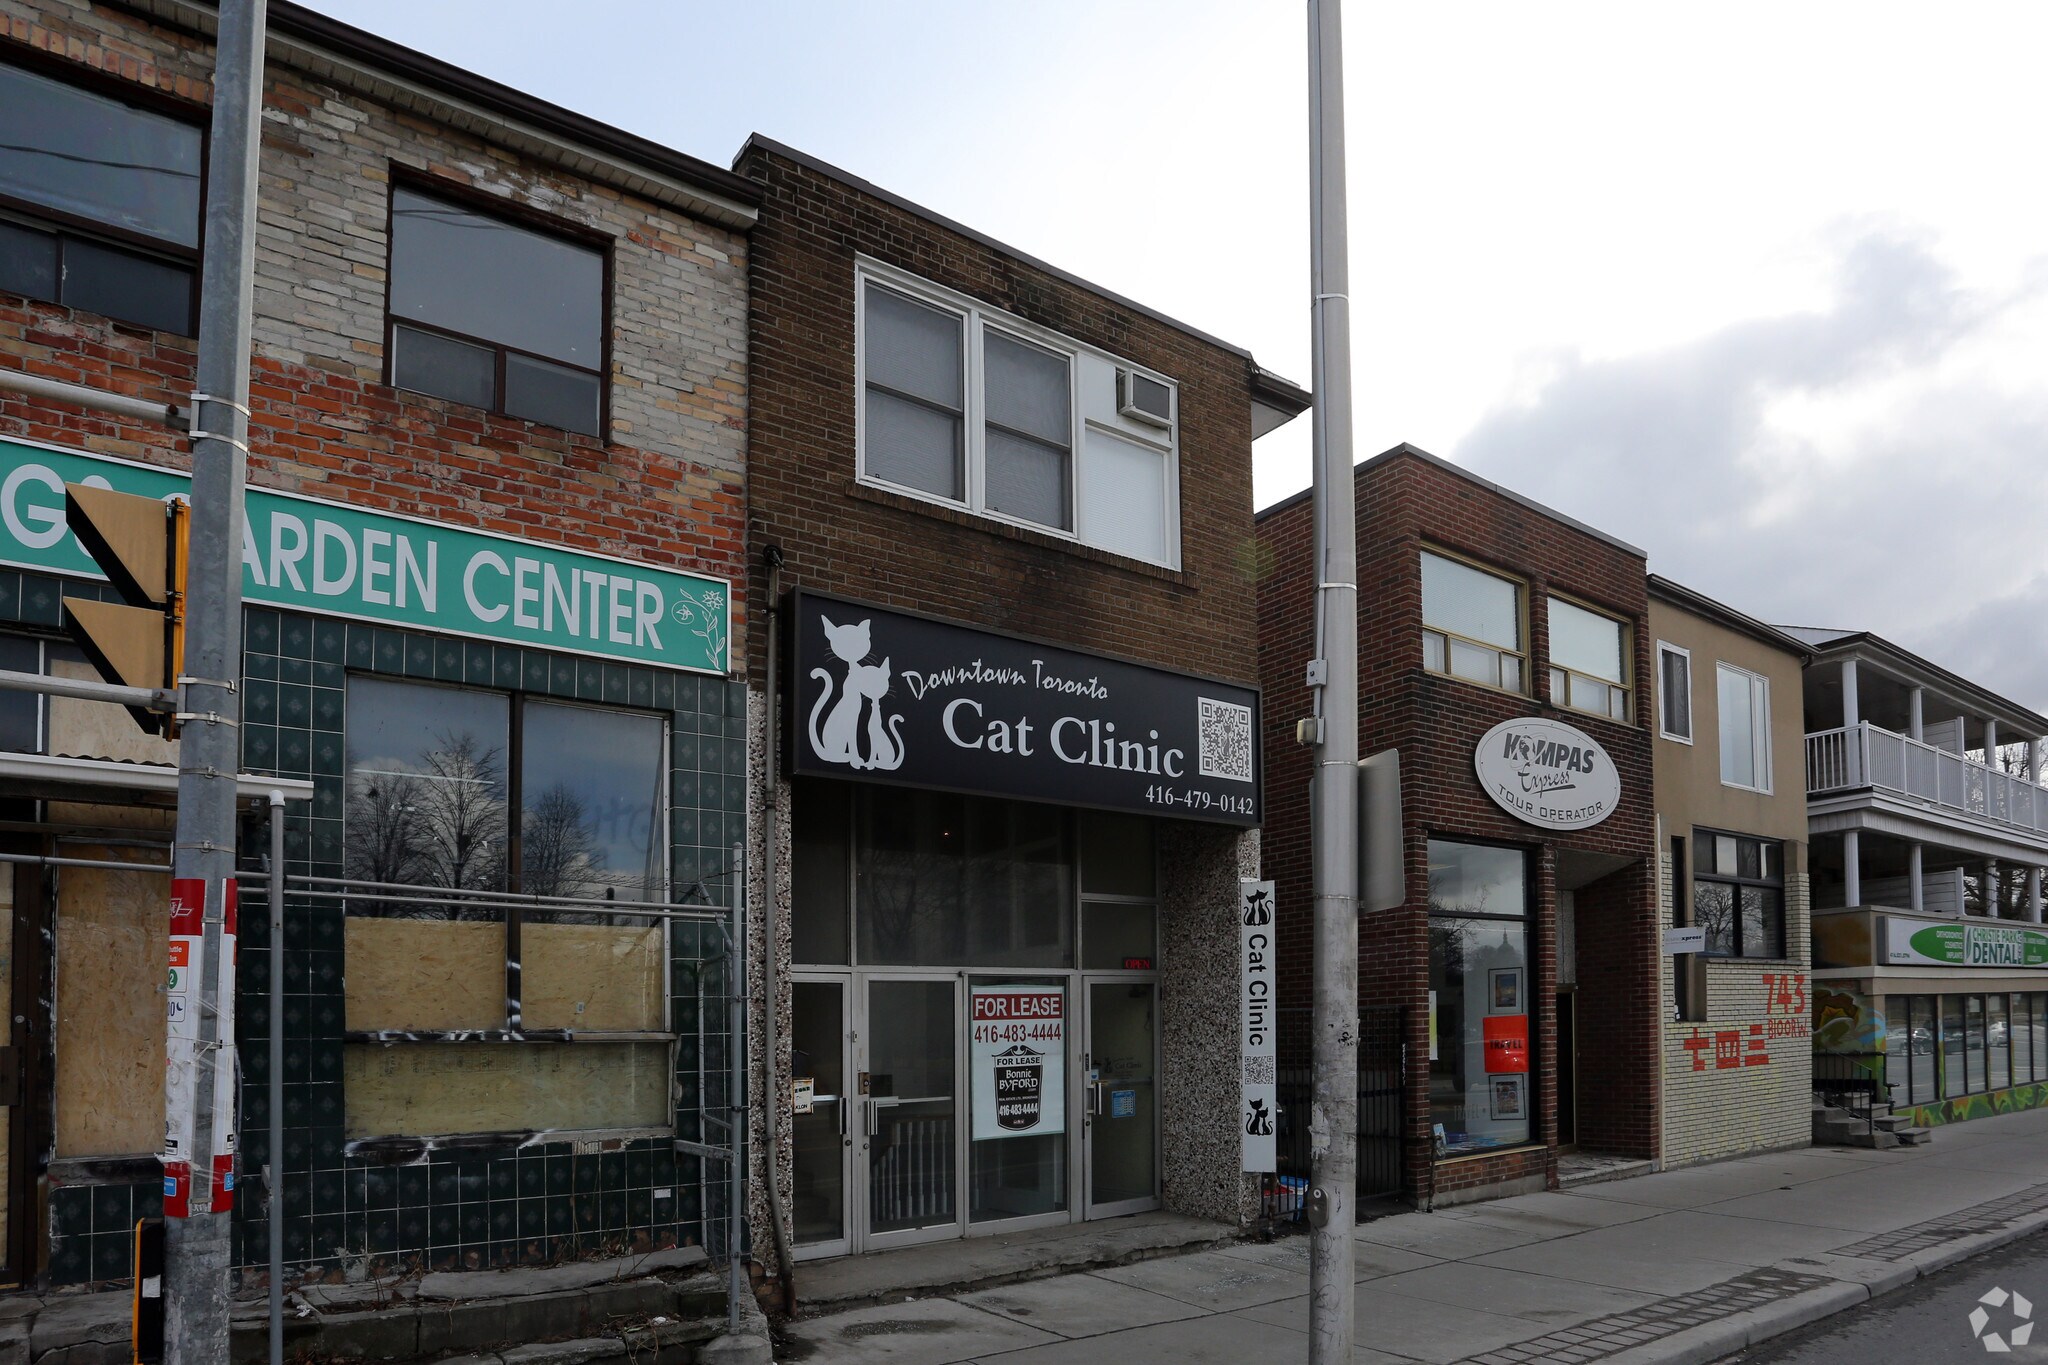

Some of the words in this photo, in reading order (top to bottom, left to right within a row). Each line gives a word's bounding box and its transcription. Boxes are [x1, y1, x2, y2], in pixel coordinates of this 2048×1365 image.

[1, 463, 114, 558] G
[160, 492, 437, 613] ARDEN
[463, 550, 664, 650] CENTER
[901, 659, 1026, 700] Downtown
[1032, 660, 1108, 699] Toronto
[942, 698, 1034, 756] Cat
[1049, 716, 1184, 778] Clinic
[1518, 762, 1570, 798] Express
[1145, 785, 1254, 815] 416-479-0142
[1499, 784, 1533, 814] TOUR
[1539, 801, 1603, 820] OPERATOR
[1972, 928, 2000, 942] CHRISTIE
[1125, 959, 1150, 969] OPEN
[1249, 933, 1268, 973] Cat
[1972, 942, 2017, 964] DENTAL
[169, 973, 175, 985] 2
[1762, 974, 1806, 1014] 743
[975, 998, 1007, 1017] FOR
[1011, 997, 1060, 1016] LEASE
[1248, 980, 1268, 1047] Clinic
[974, 1023, 1061, 1043] 416-483-4444
[1489, 1039, 1523, 1049] TRAVEL
[997, 1058, 1013, 1066] FOR
[1016, 1057, 1040, 1065] LEASE
[1006, 1069, 1031, 1079] Bonnie
[999, 1103, 1038, 1116] 416-483-4444
